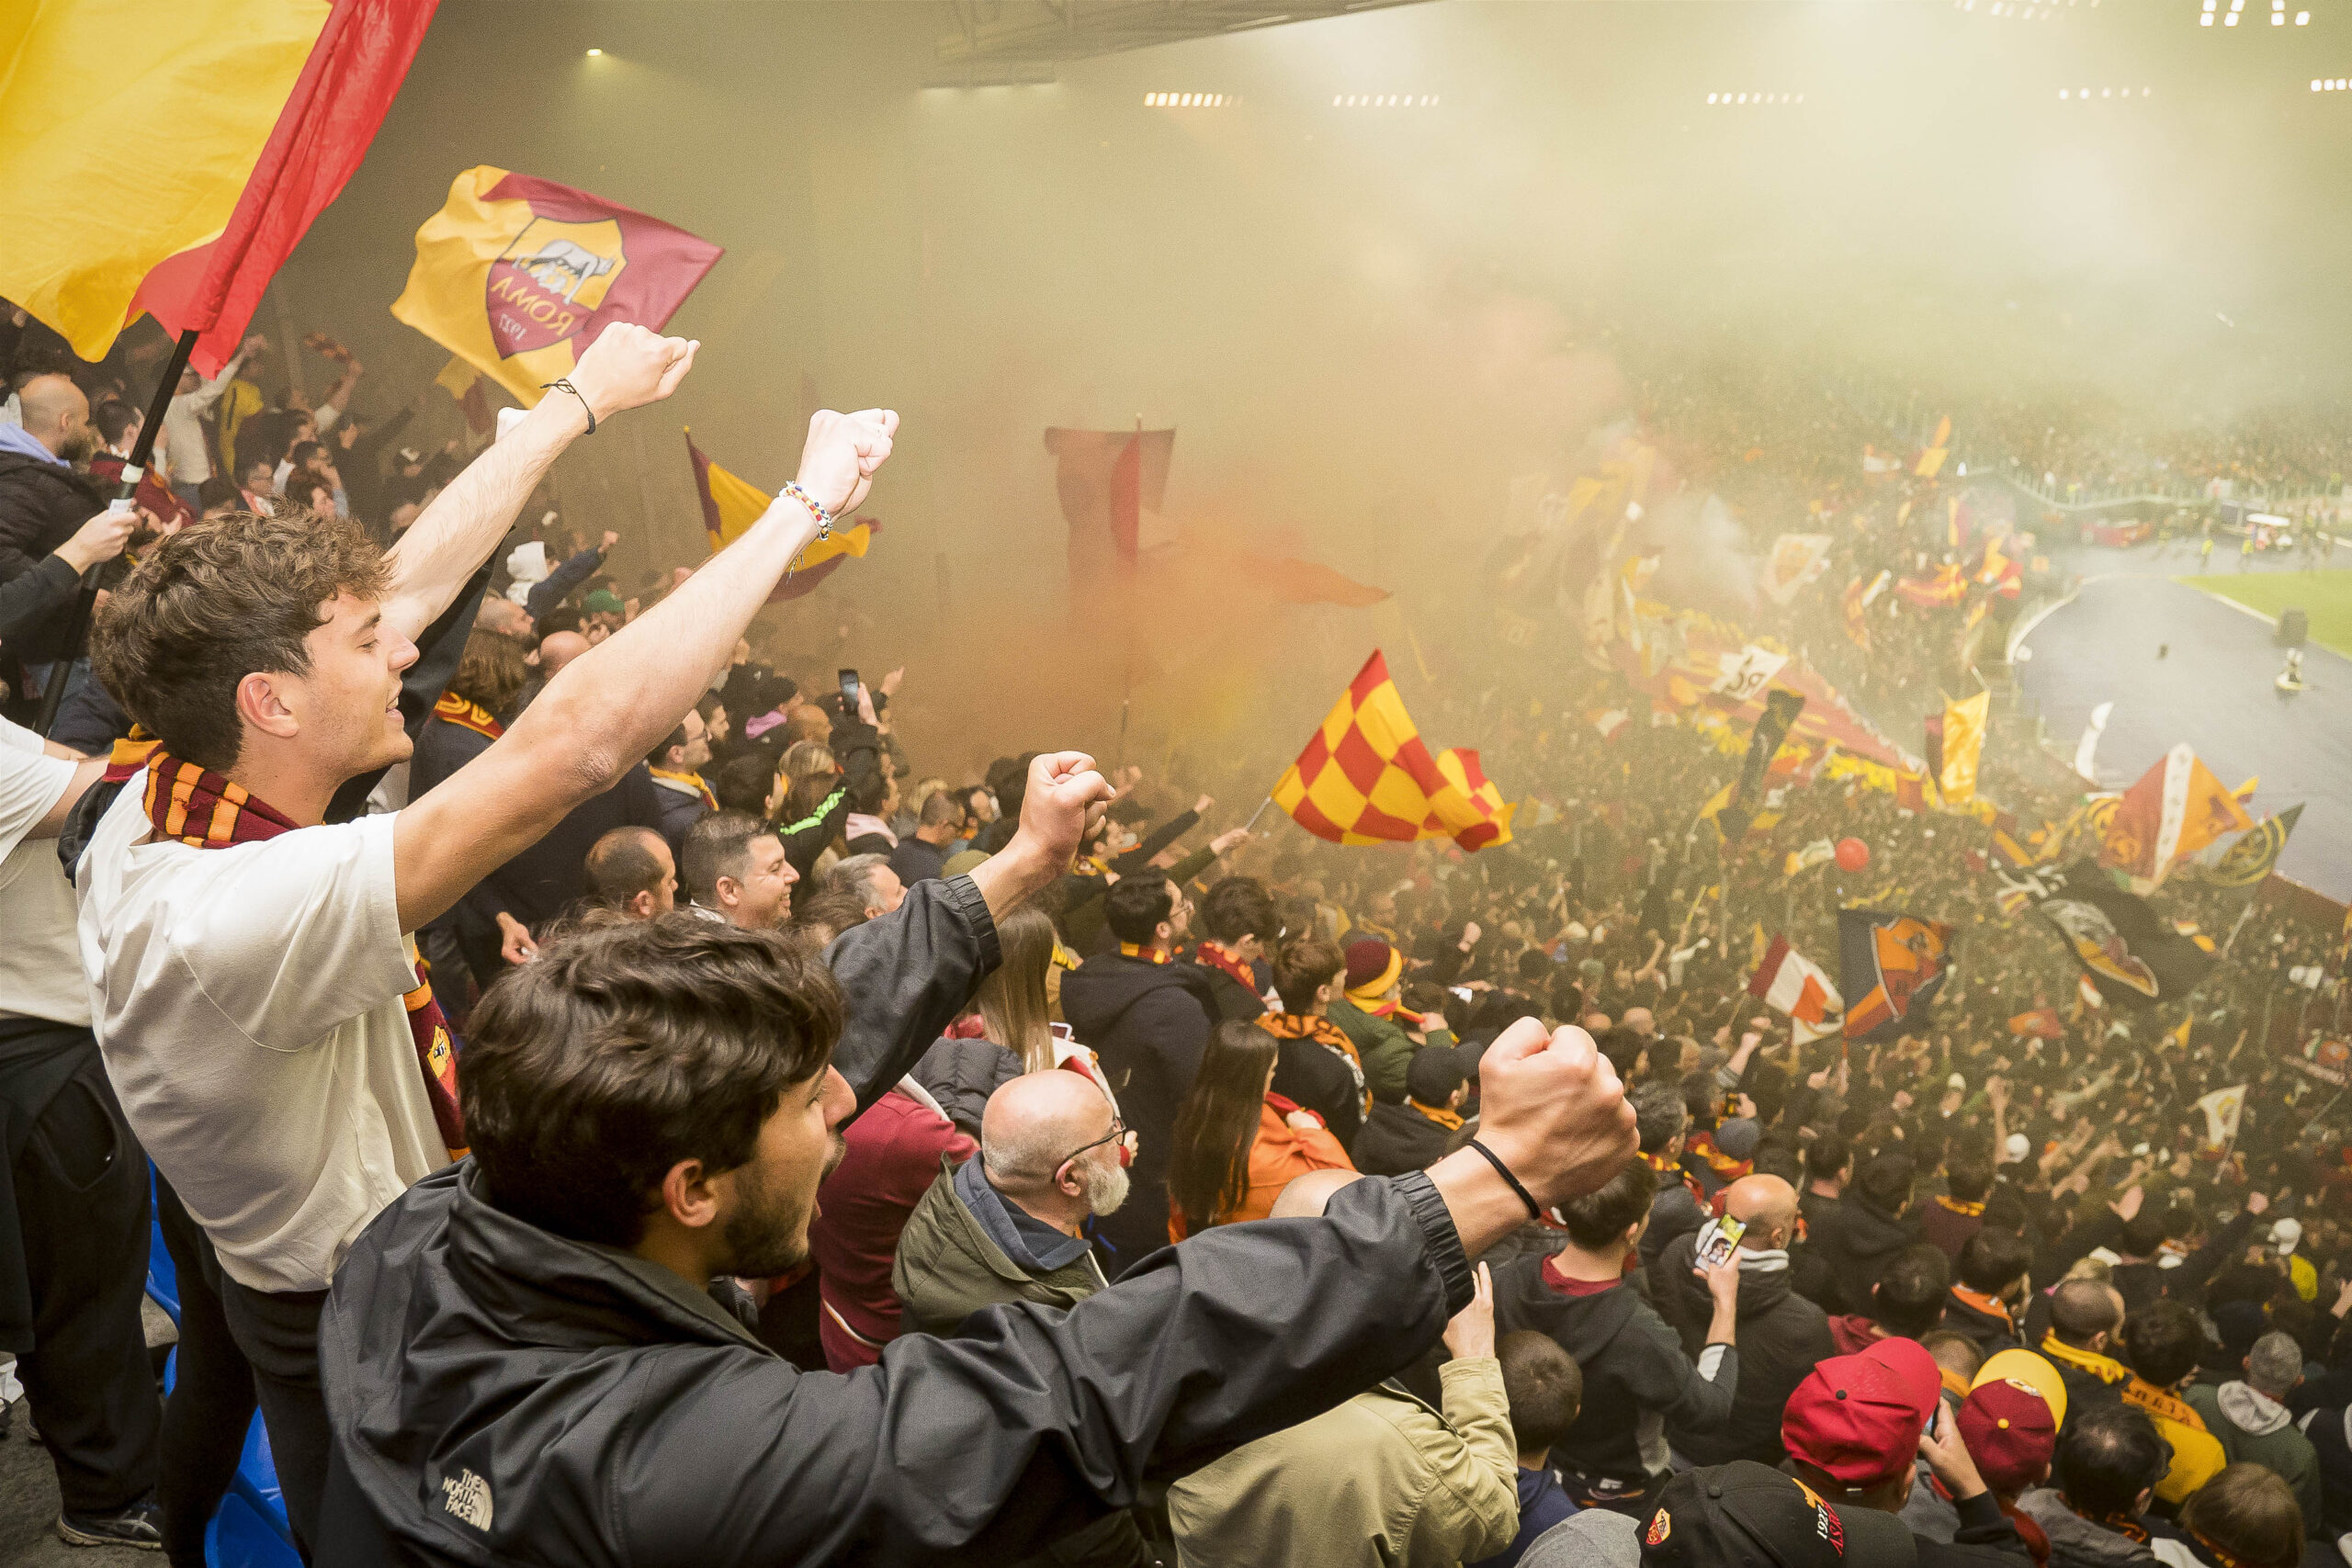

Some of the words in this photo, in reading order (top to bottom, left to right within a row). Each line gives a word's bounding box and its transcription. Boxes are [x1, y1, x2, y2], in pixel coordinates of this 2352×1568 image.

[441, 1476, 478, 1506] NORTH
[461, 1468, 481, 1489] THE
[445, 1495, 473, 1520] FACE
[1816, 1504, 1828, 1540] 1927
